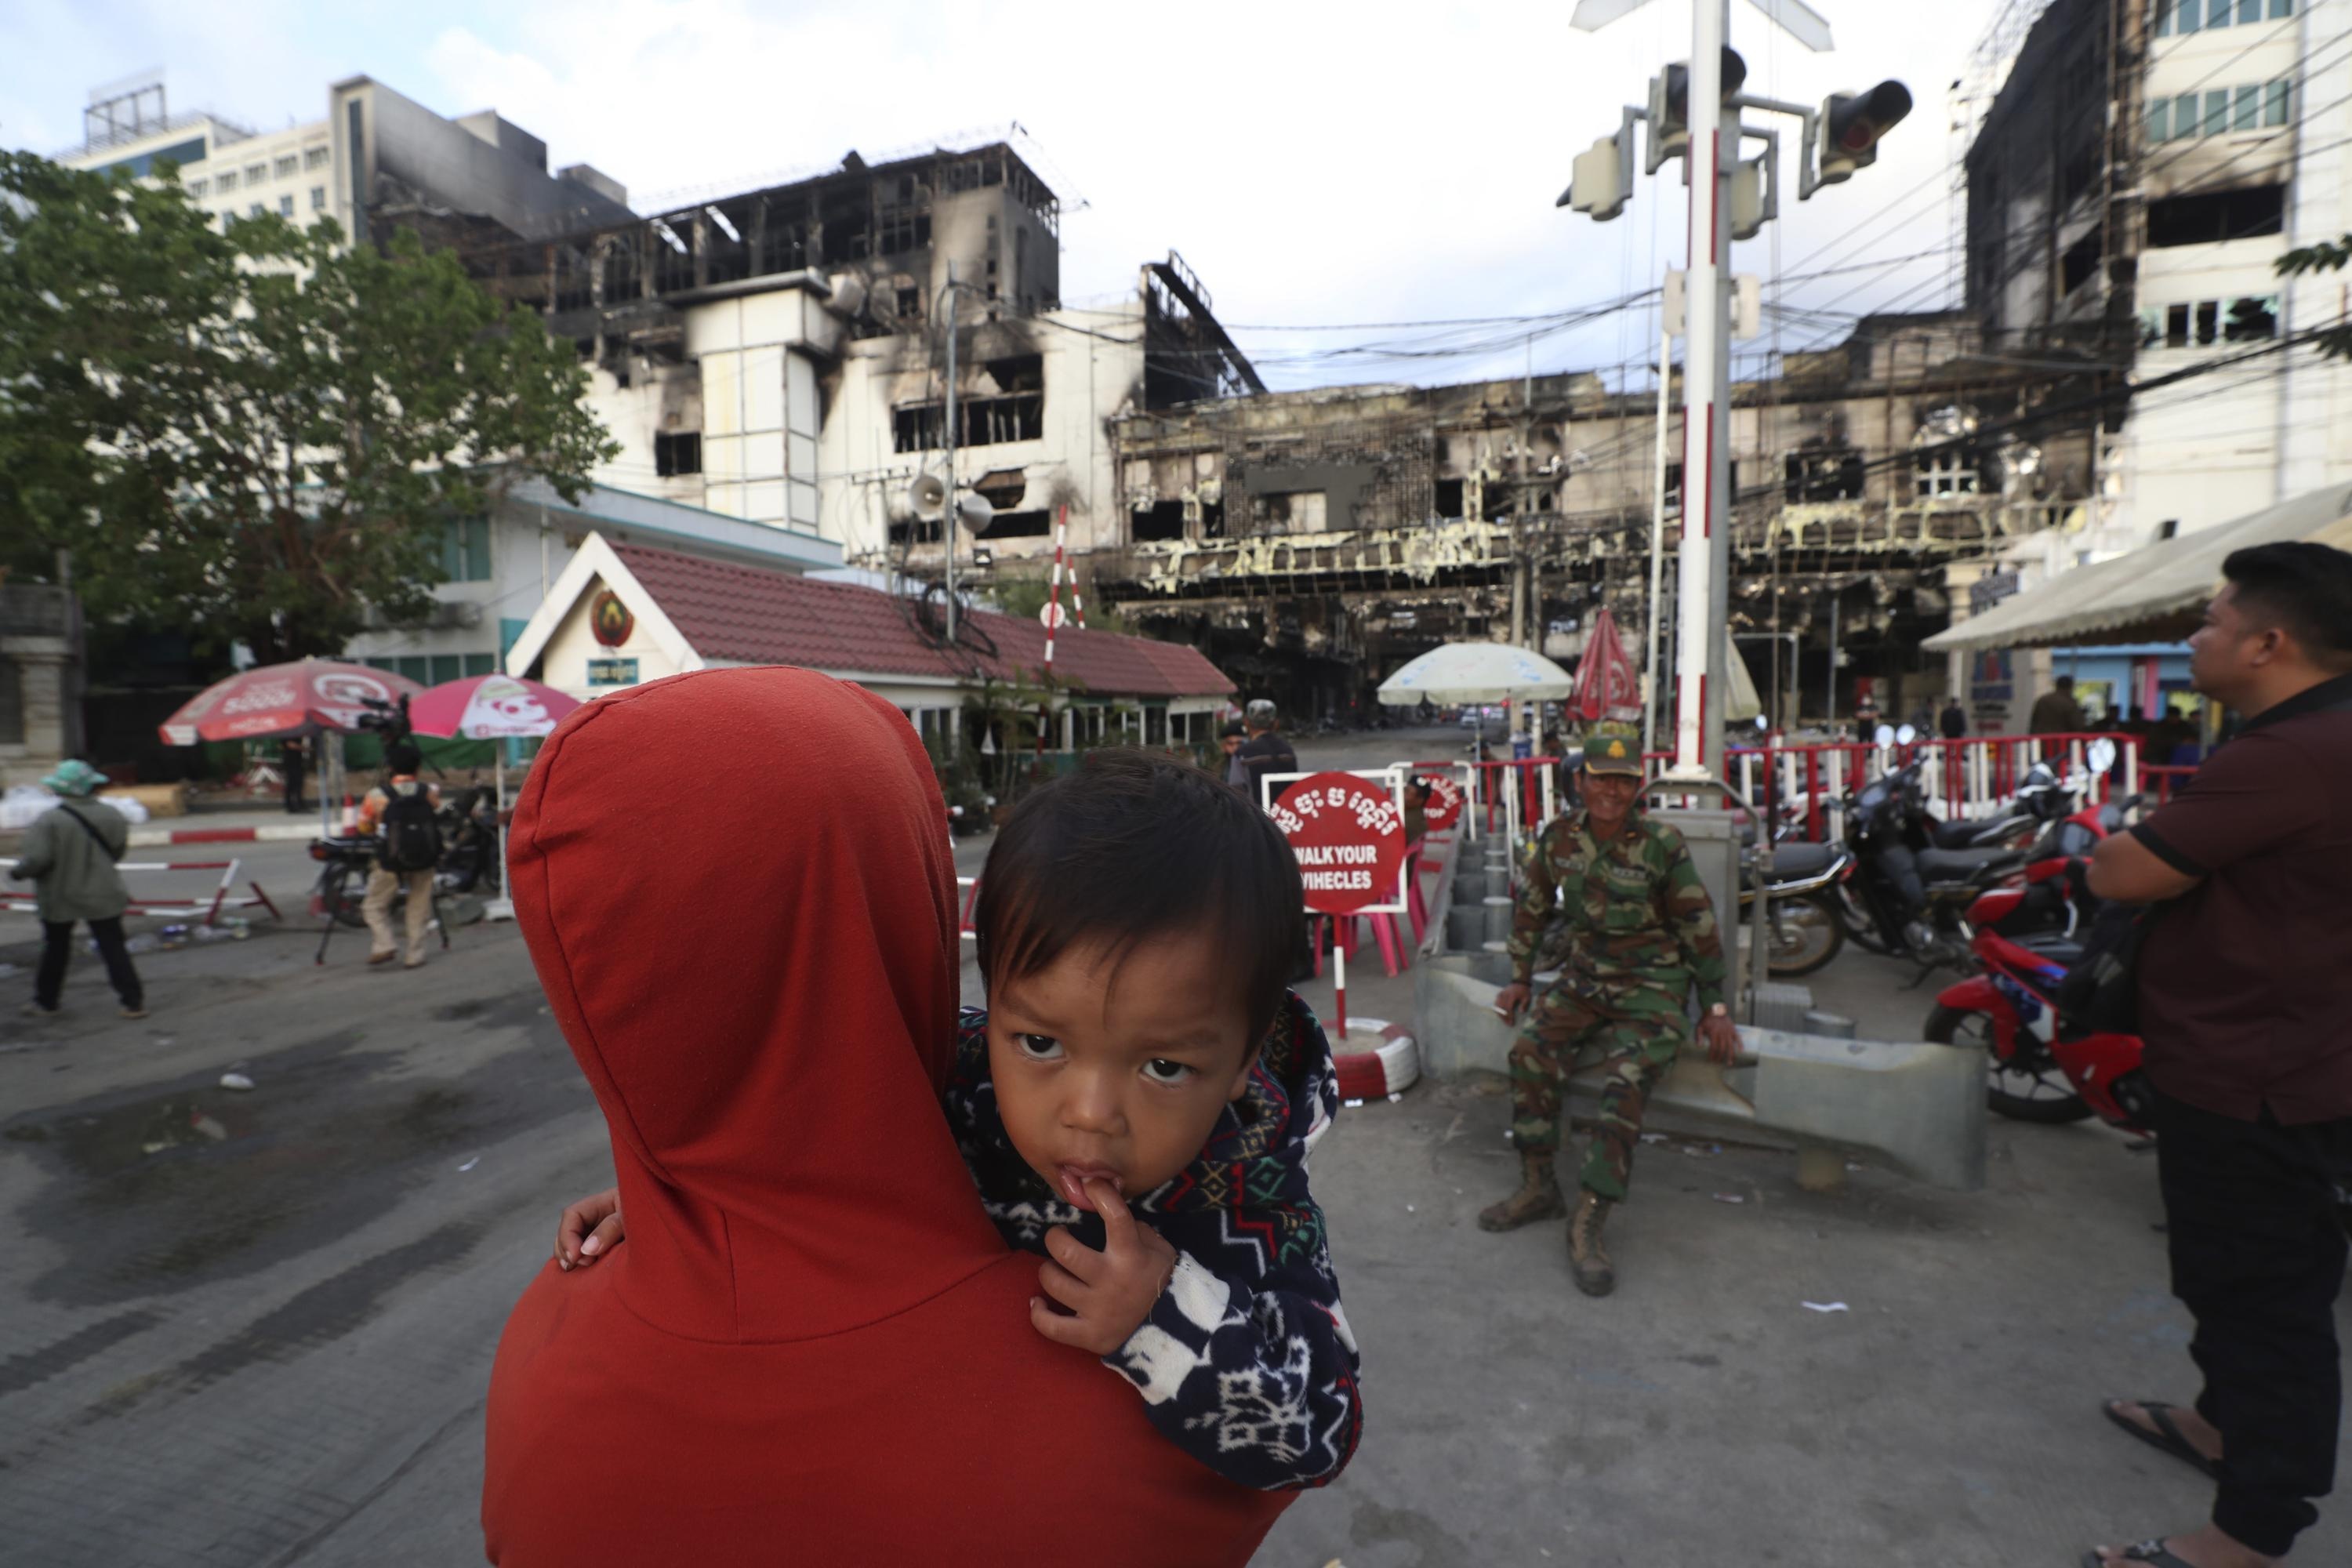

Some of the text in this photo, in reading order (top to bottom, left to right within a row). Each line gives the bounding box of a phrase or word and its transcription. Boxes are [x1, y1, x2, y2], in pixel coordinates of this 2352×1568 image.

[1423, 808, 1446, 818] TOP
[1334, 844, 1377, 864] YOUR
[1300, 870, 1372, 890] VIHECLES
